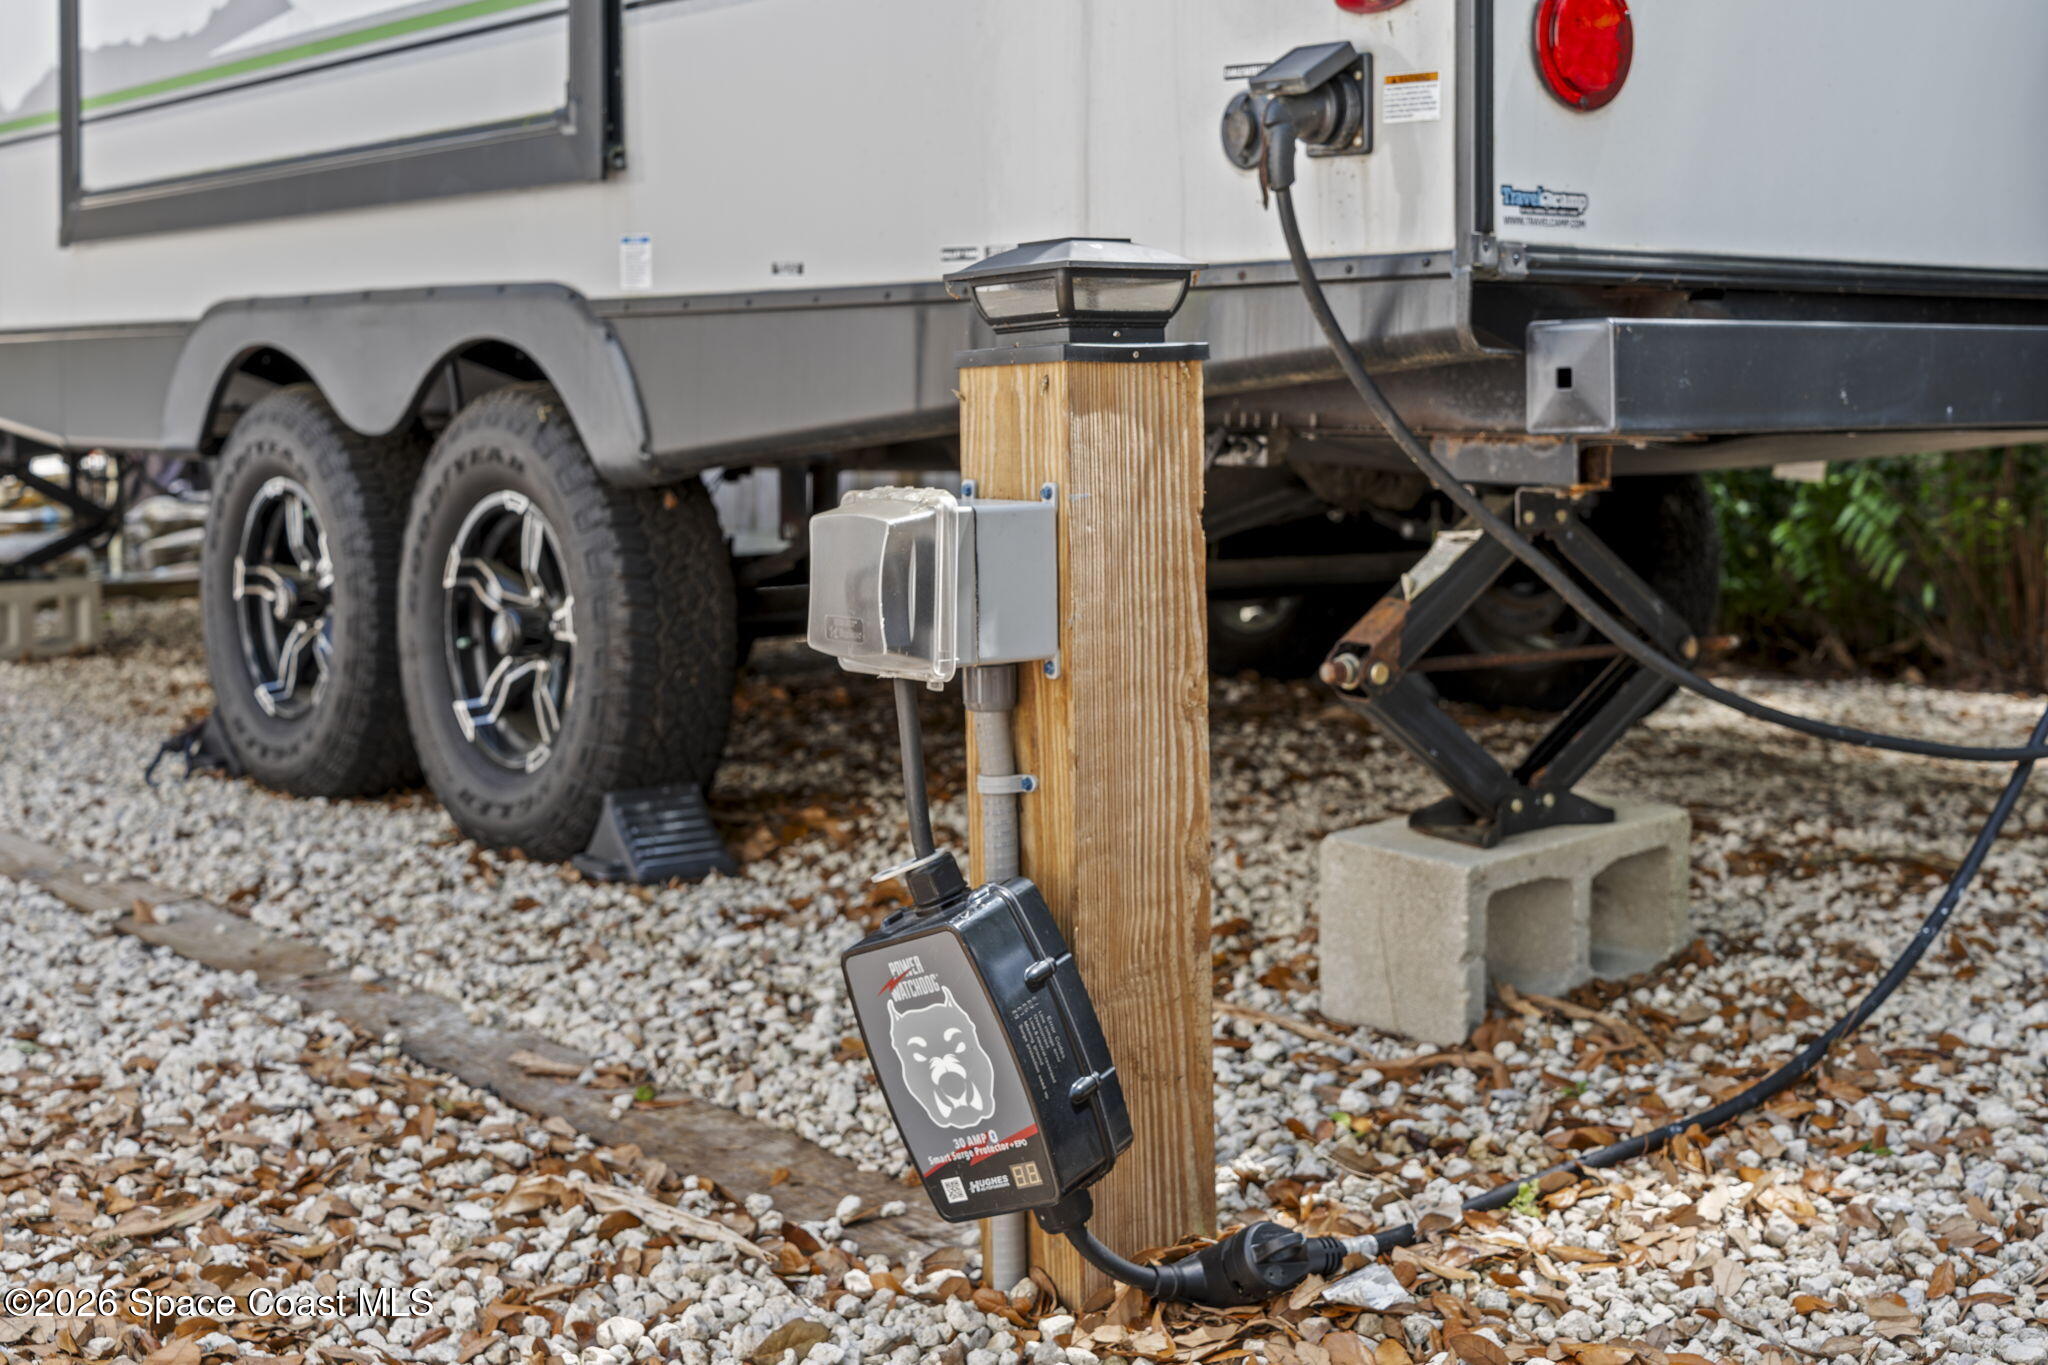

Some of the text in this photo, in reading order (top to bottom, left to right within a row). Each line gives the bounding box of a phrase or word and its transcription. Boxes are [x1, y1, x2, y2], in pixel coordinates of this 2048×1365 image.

[888, 955, 925, 978] POWER
[891, 973, 940, 1002] WATCHDOG
[953, 1132, 987, 1149] 30 AMP
[928, 1153, 952, 1165] Smart
[952, 1149, 975, 1161] Surge
